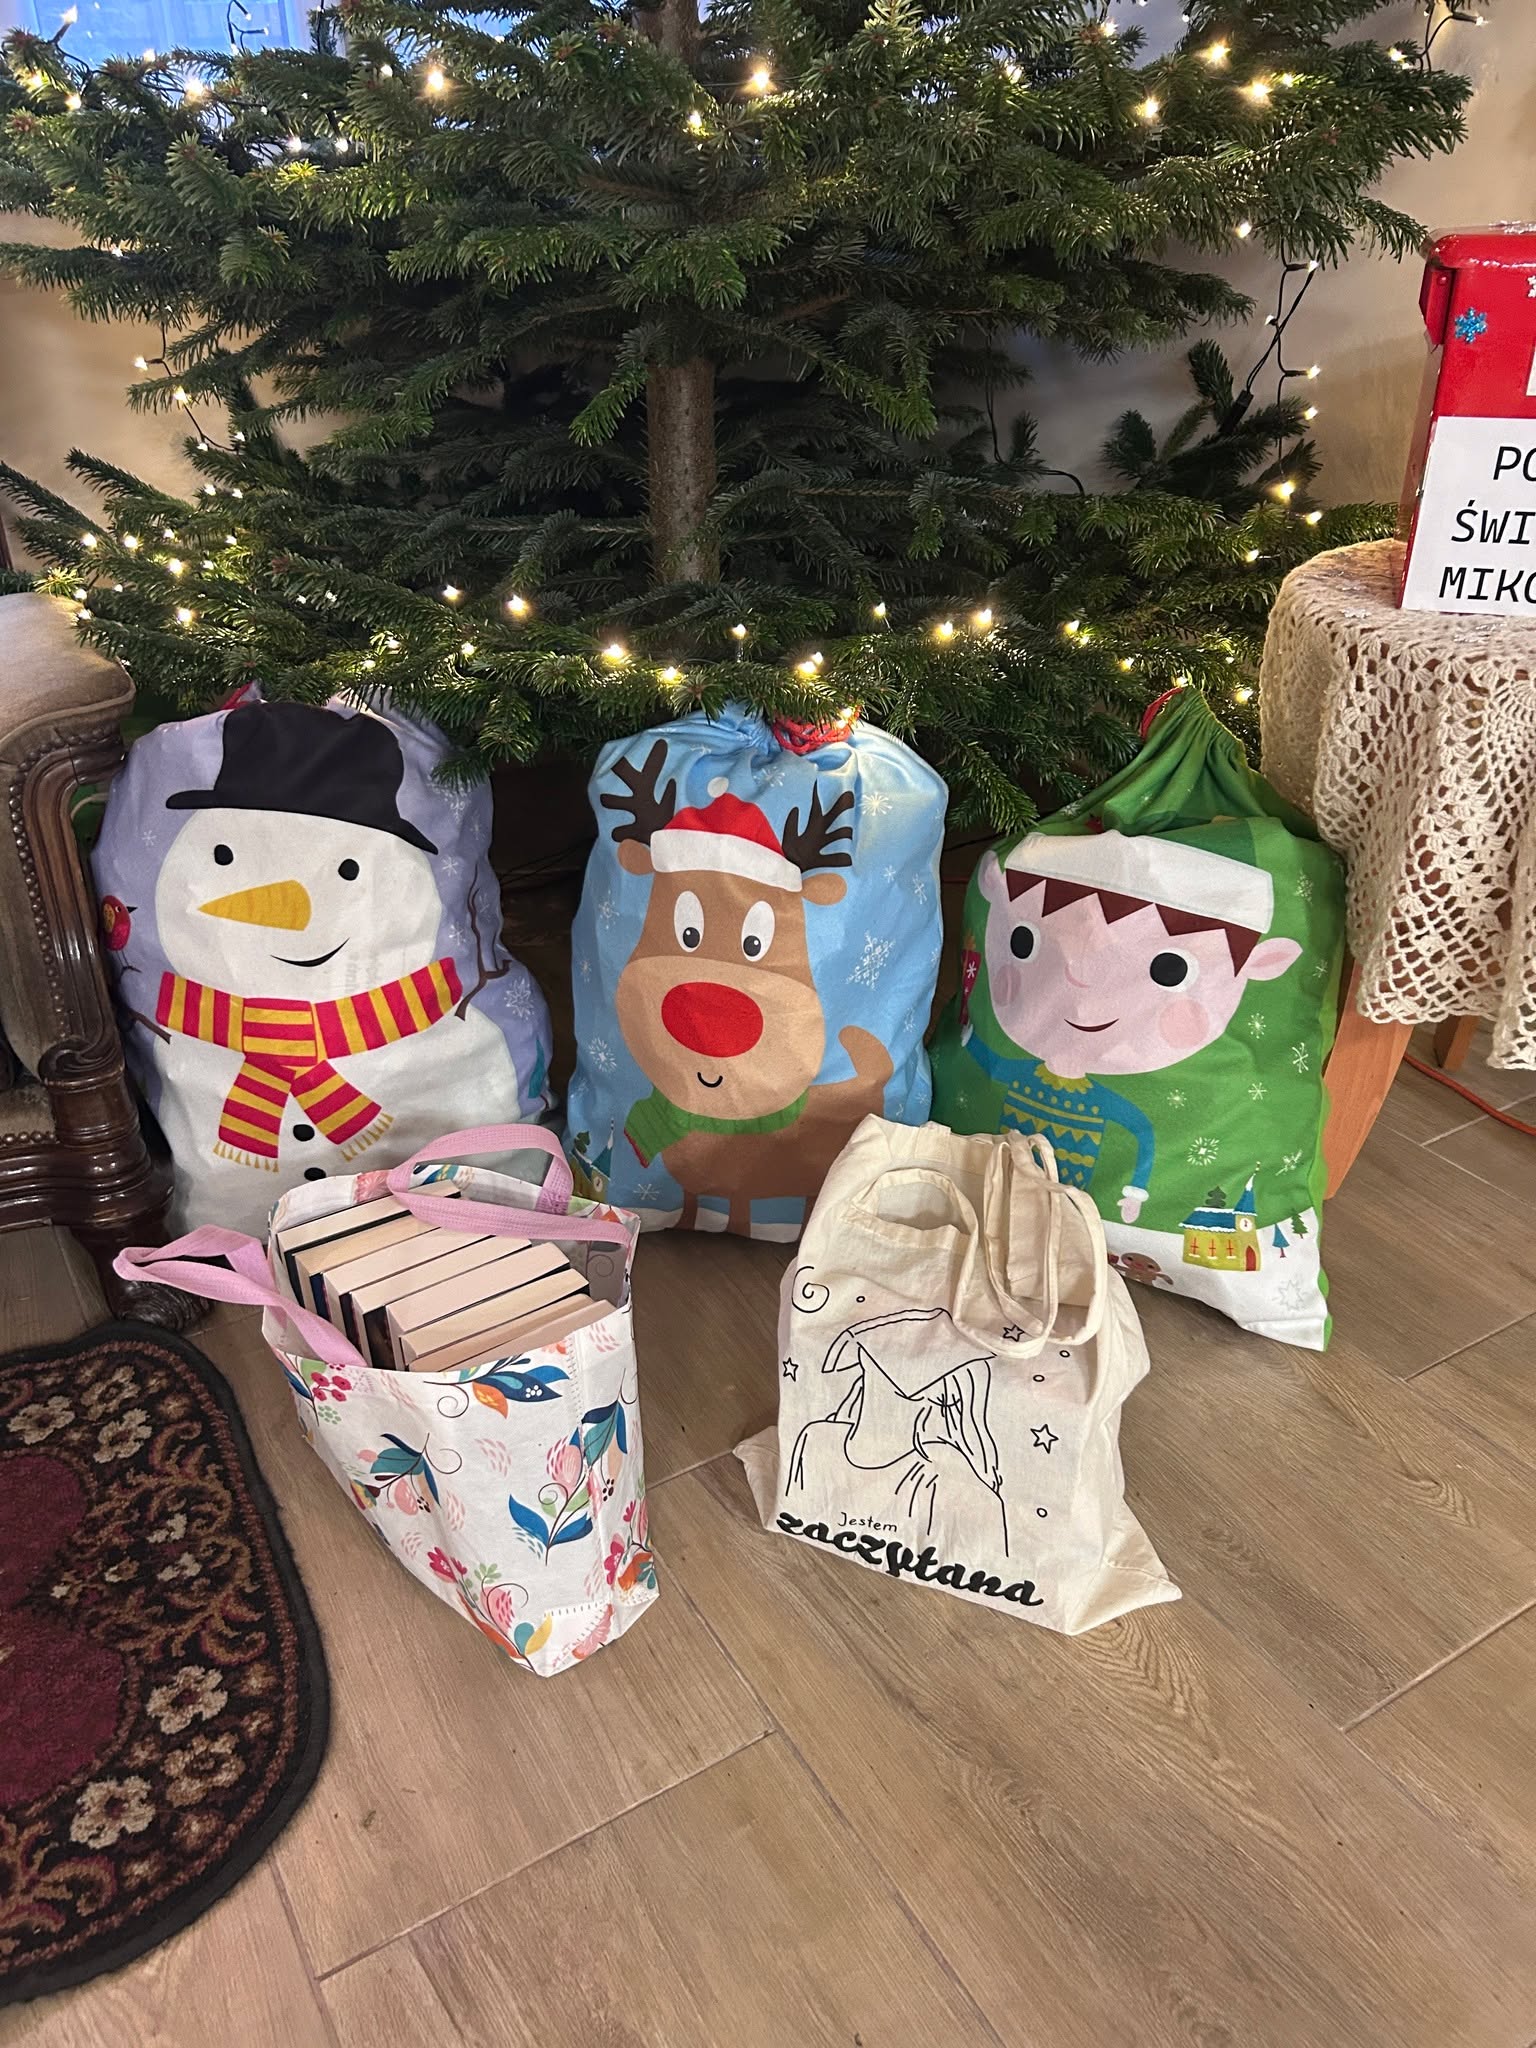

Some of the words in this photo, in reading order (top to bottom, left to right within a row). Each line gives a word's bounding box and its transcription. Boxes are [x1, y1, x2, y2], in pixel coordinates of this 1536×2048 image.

[1451, 499, 1536, 545] ŚWI
[837, 1511, 898, 1533] Jestem
[776, 1512, 1044, 1606] zaczytana
